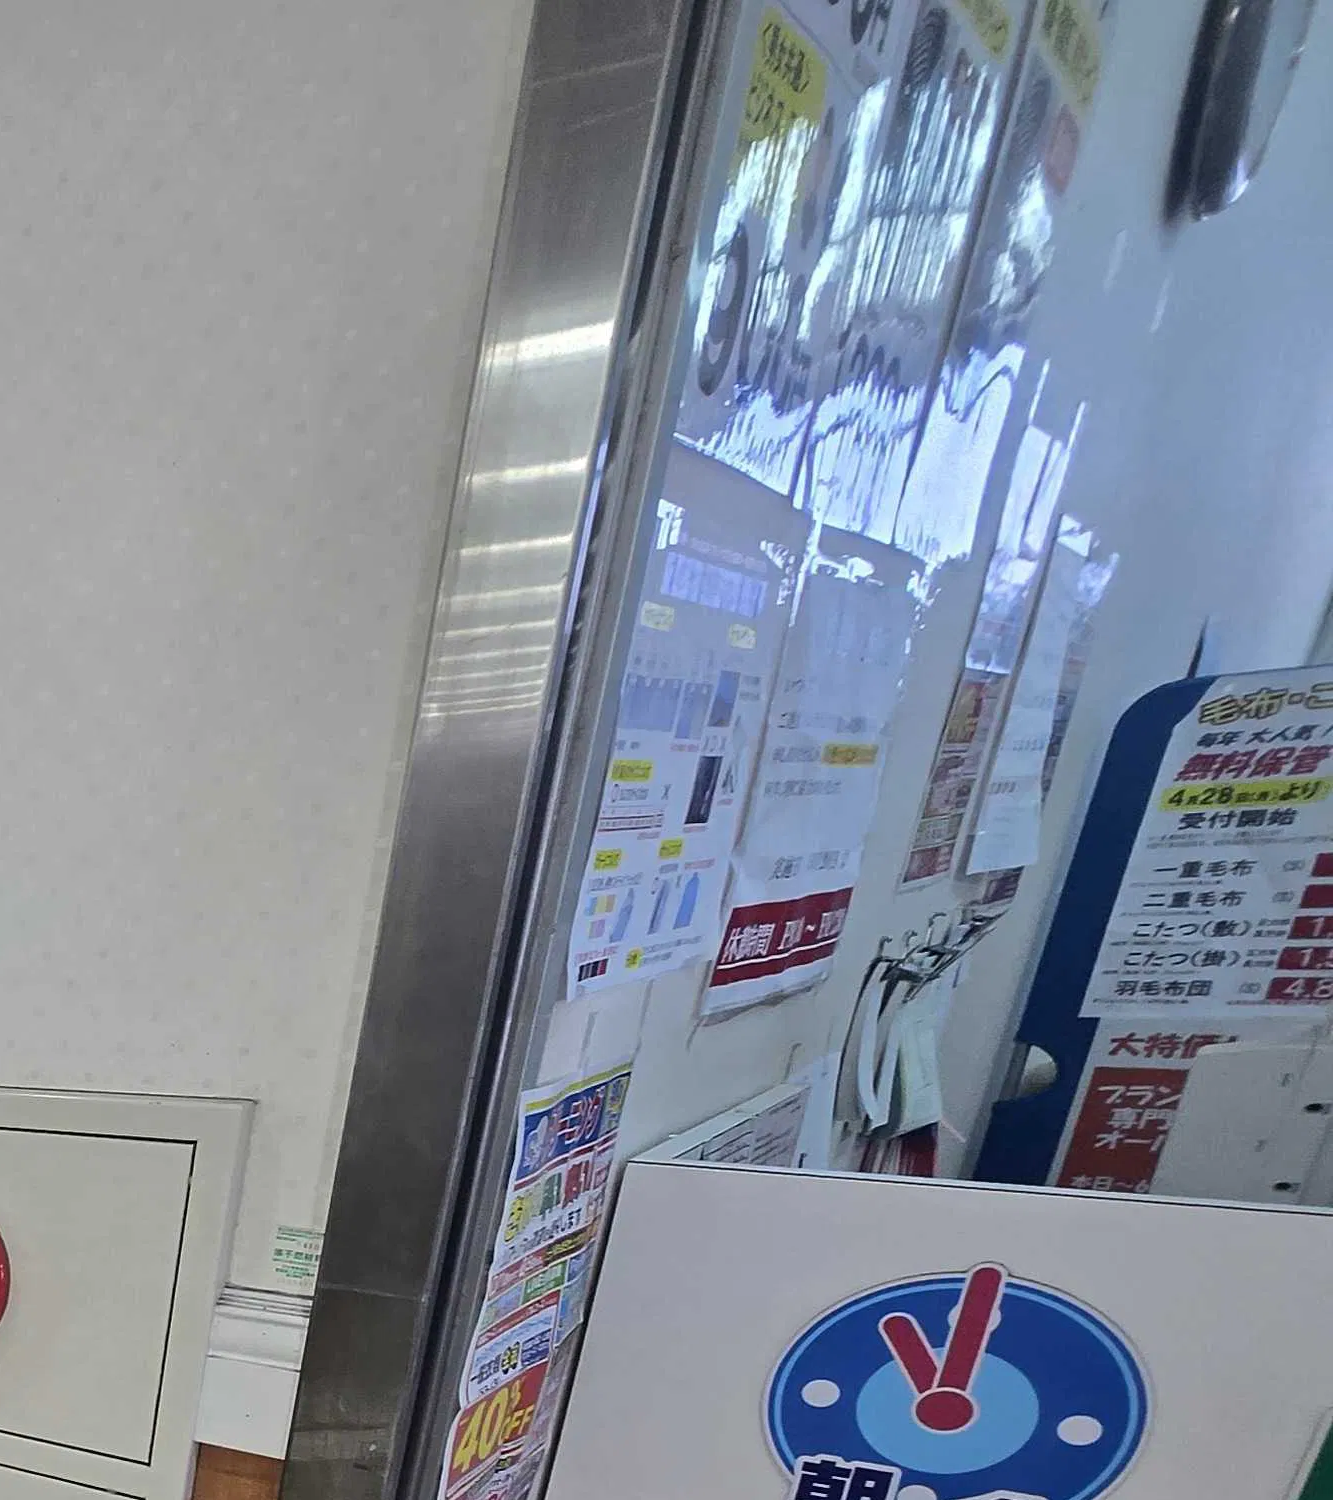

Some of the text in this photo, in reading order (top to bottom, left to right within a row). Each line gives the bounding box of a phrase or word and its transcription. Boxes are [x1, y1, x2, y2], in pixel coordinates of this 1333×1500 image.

[1173, 744, 1333, 783] 無料保管
[1178, 807, 1300, 832] 受付開始
[1153, 859, 1257, 880] 一重毛布
[1142, 890, 1248, 909] 二重毛布
[1114, 979, 1215, 999] 羽毛布団
[1108, 1032, 1240, 1060] 大特価
[1107, 1107, 1175, 1131] 専門
